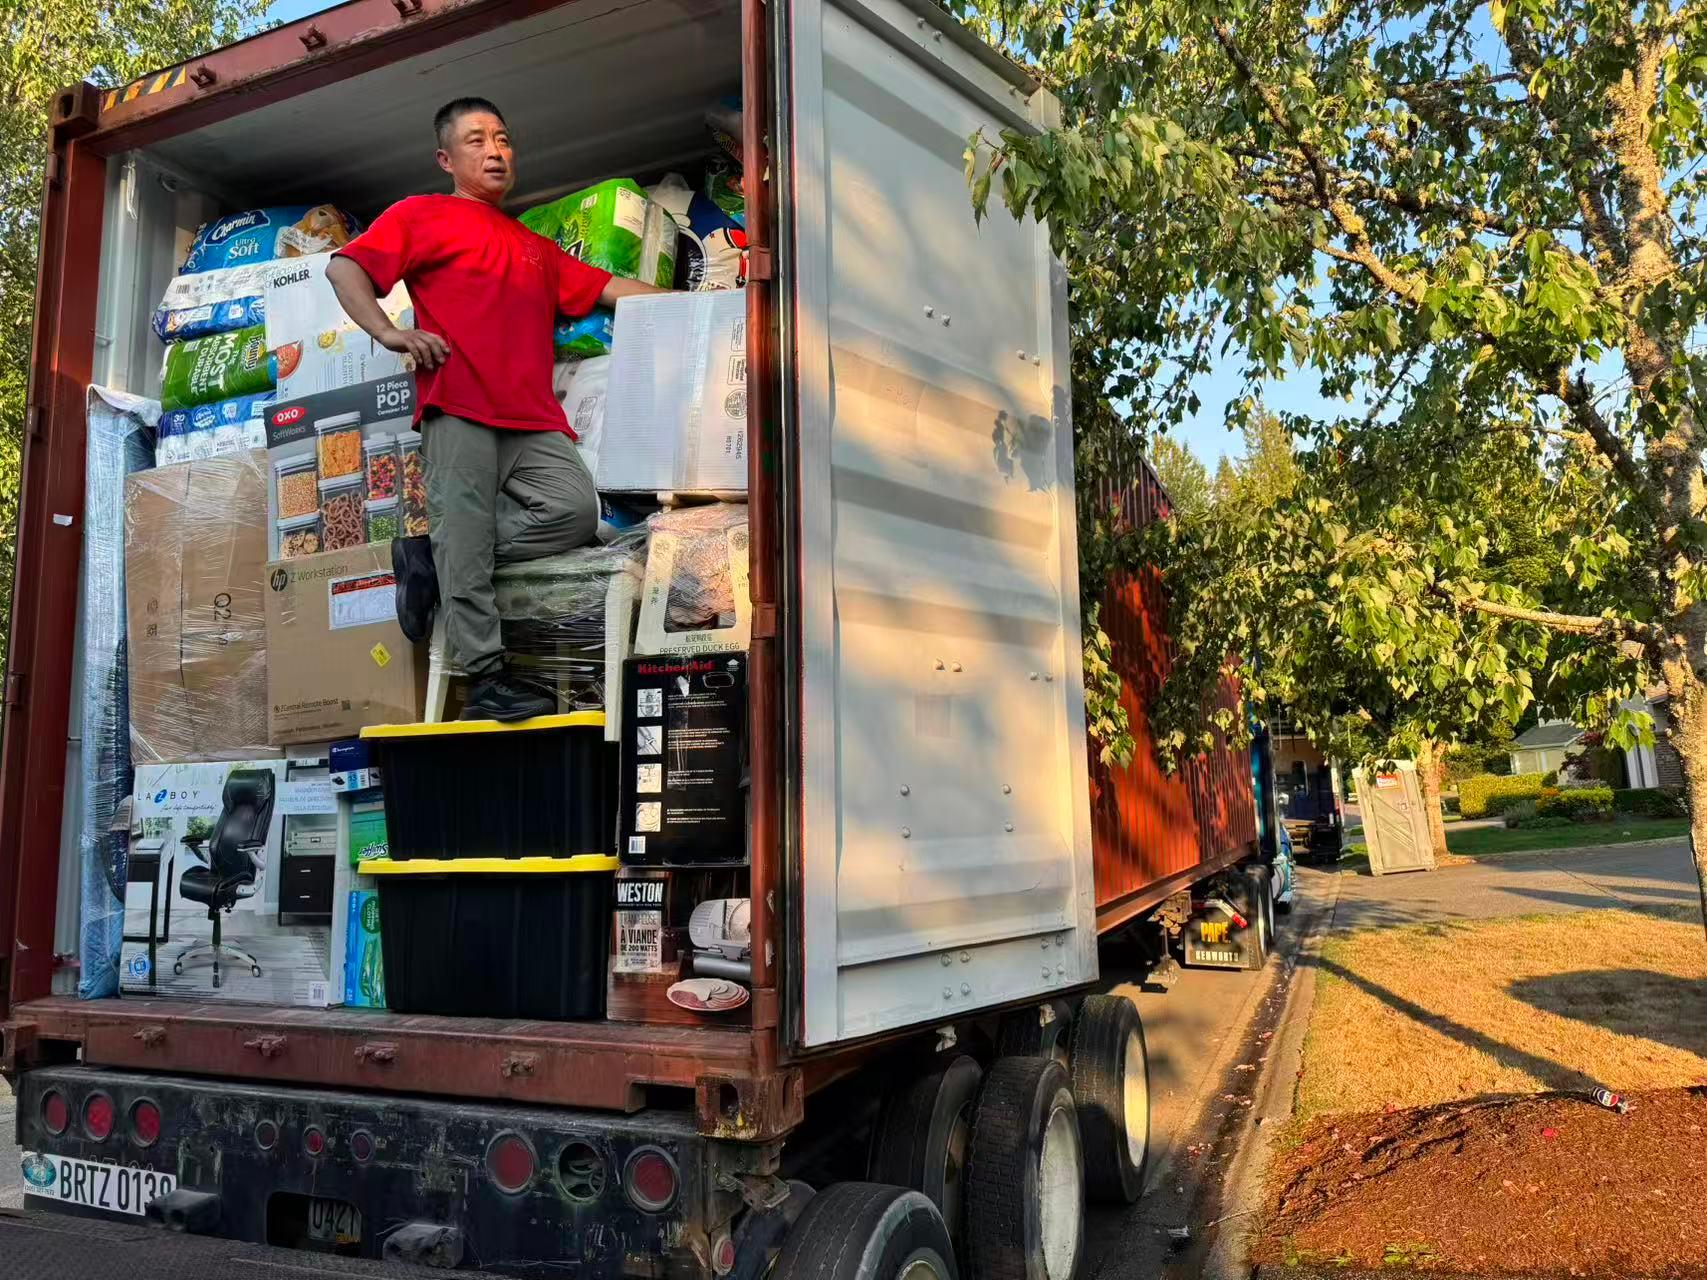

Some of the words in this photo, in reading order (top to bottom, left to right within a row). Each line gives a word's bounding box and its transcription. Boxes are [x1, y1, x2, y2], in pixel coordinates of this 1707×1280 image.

[212, 213, 256, 240] Charmin
[228, 242, 260, 260] Soft
[235, 237, 256, 246] Ultra
[273, 269, 310, 288] KOHLER
[245, 334, 264, 370] Bounty
[191, 347, 209, 395] DURABLE
[199, 336, 222, 393] ABSORBENT
[207, 333, 239, 392] MOST
[376, 383, 385, 393] 12
[386, 380, 409, 391] Piece
[376, 389, 411, 409] POP
[276, 409, 299, 422] OXO
[272, 425, 306, 440] SoftWorks
[272, 571, 287, 591] hp
[290, 573, 296, 583] Z
[298, 564, 348, 581] Workstation
[660, 645, 700, 656] PRESERVED
[702, 643, 724, 652] DUCK
[725, 642, 740, 650] EGG
[637, 661, 714, 674] KitchenAid
[617, 882, 664, 903] WESTON
[628, 929, 657, 944] VIANDE
[620, 944, 627, 952] DE
[628, 944, 640, 952] 200
[641, 944, 658, 952] WATTS
[60, 1159, 111, 1208] BRTZ
